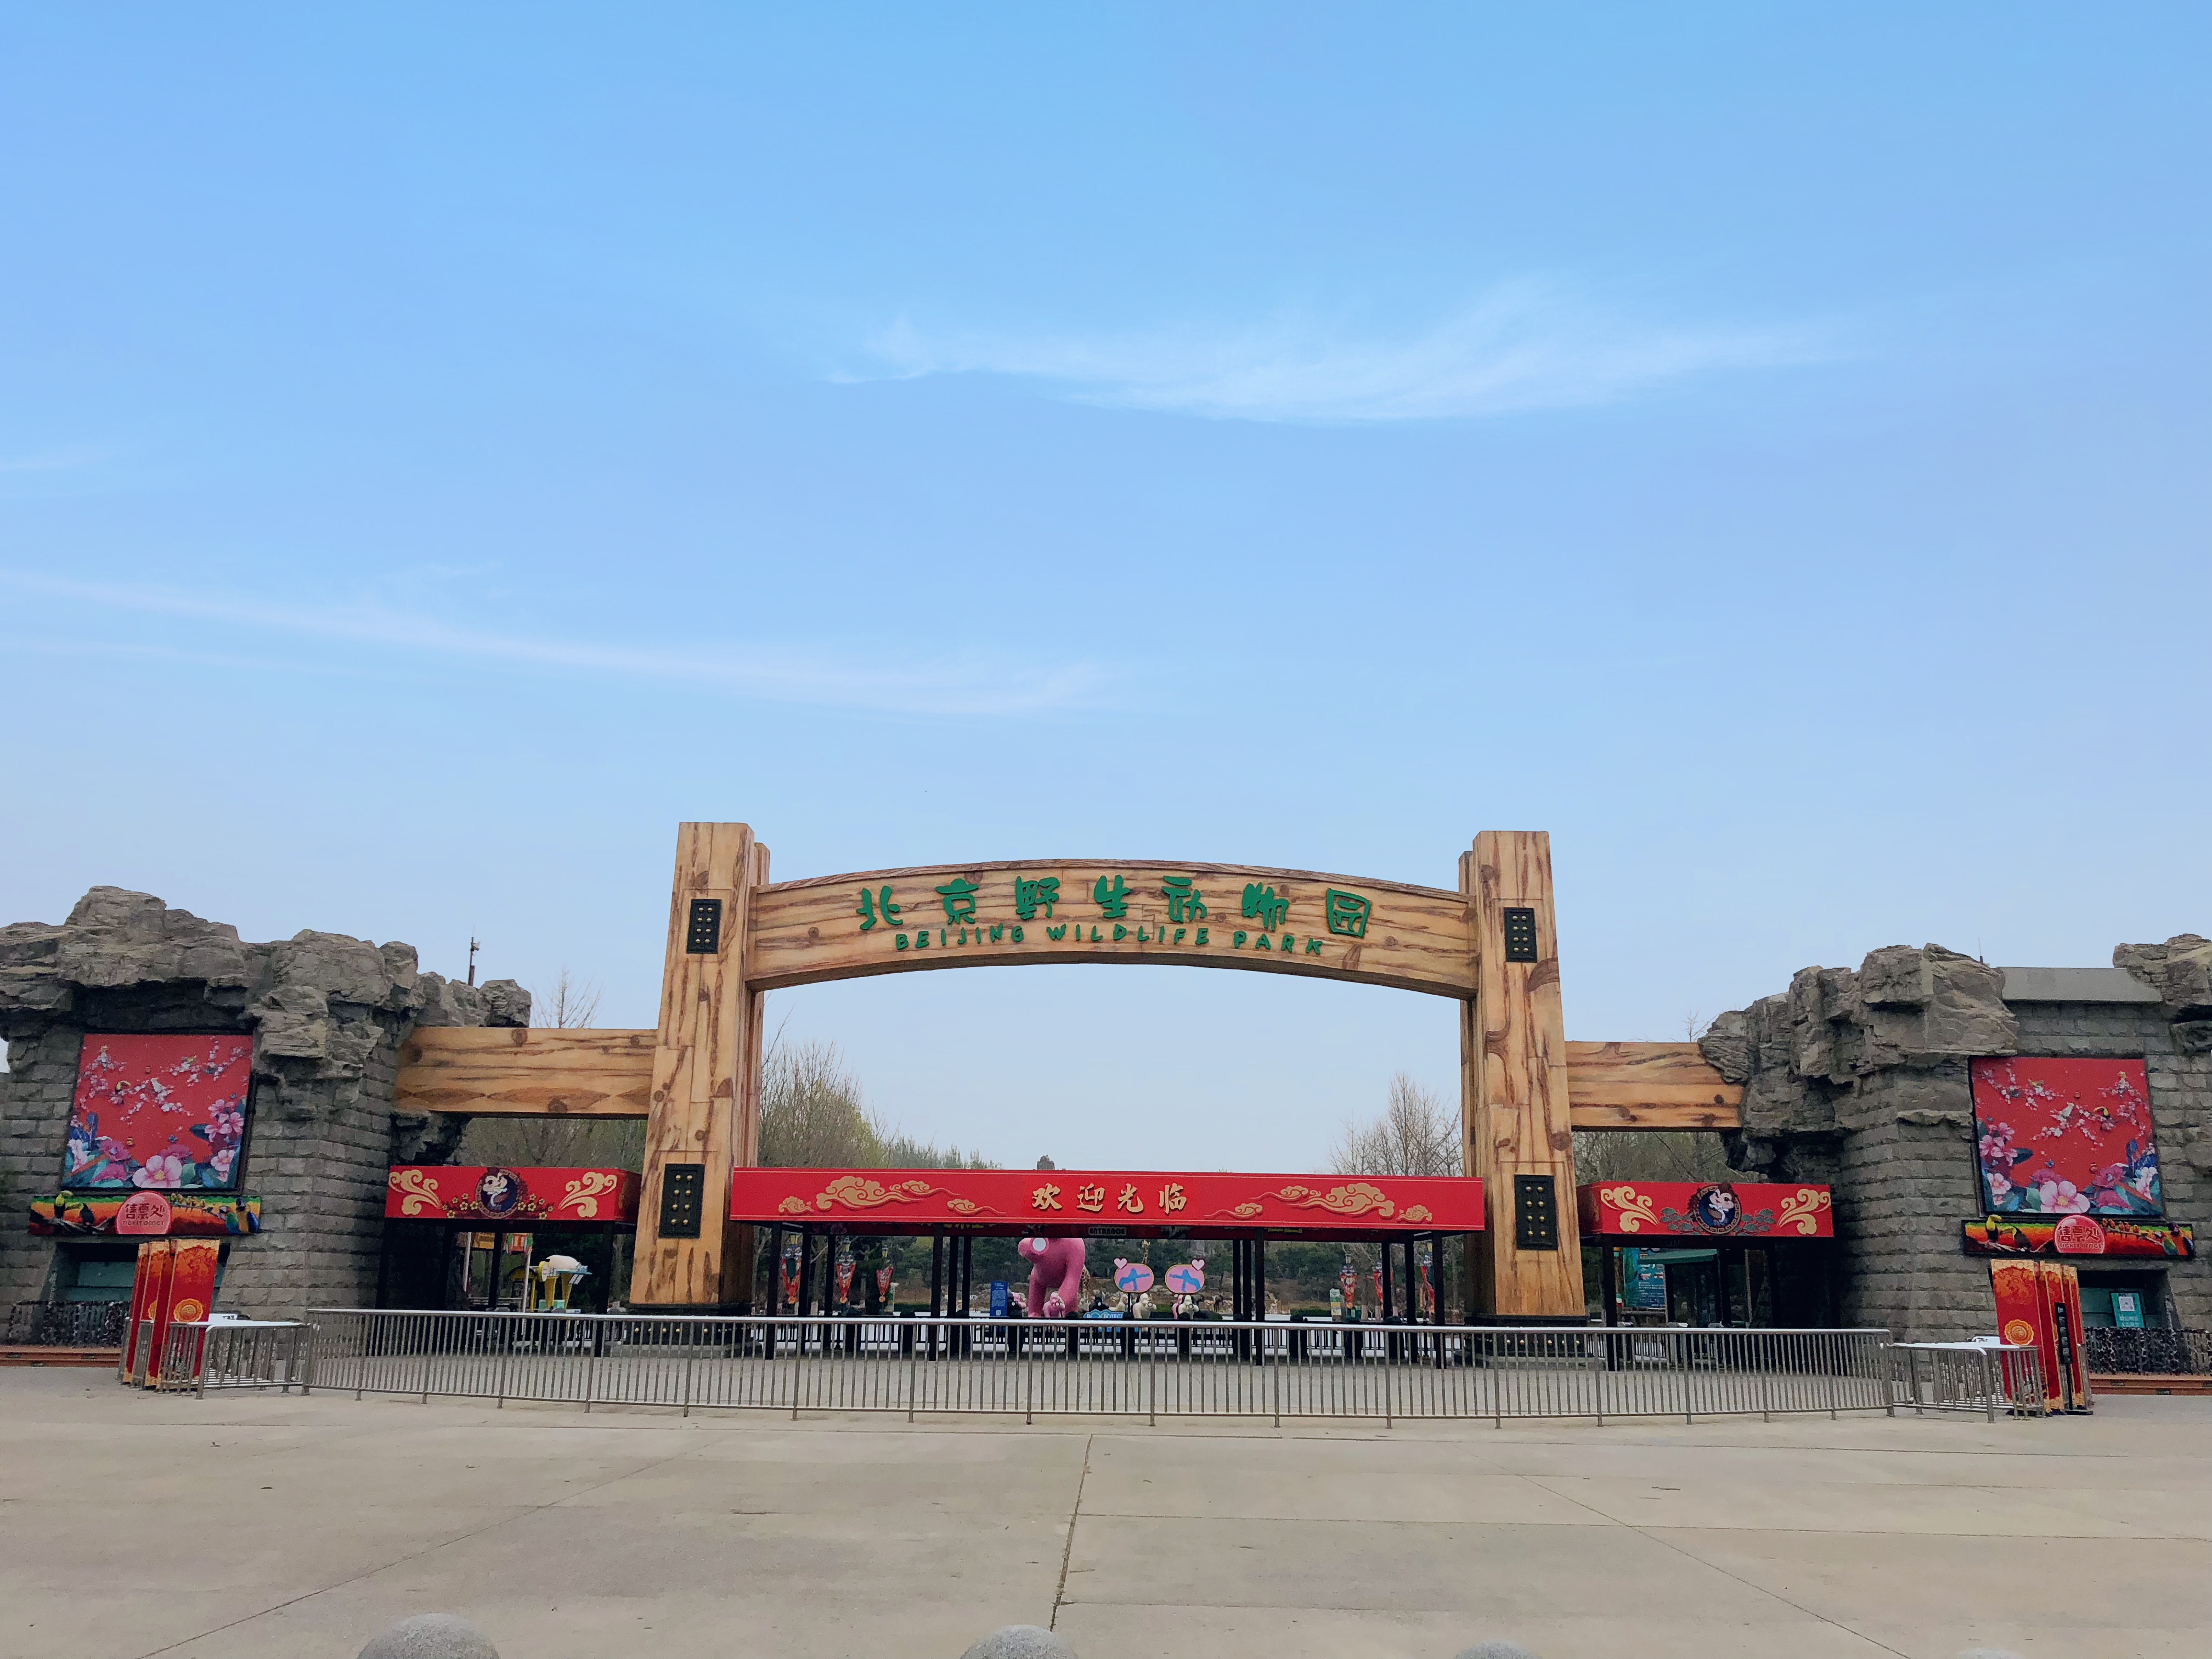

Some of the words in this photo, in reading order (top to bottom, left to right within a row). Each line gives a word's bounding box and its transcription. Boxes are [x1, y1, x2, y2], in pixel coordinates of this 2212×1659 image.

[857, 876, 1370, 938] 北京野生动物园
[896, 924, 1024, 950] BEIJING
[1047, 924, 1209, 945] WILDLIFE
[1234, 931, 1323, 954] PARK
[125, 1203, 165, 1220] 售票处
[1032, 1183, 1187, 1214] 欢迎光临
[2058, 1225, 2100, 1242] 售票处
